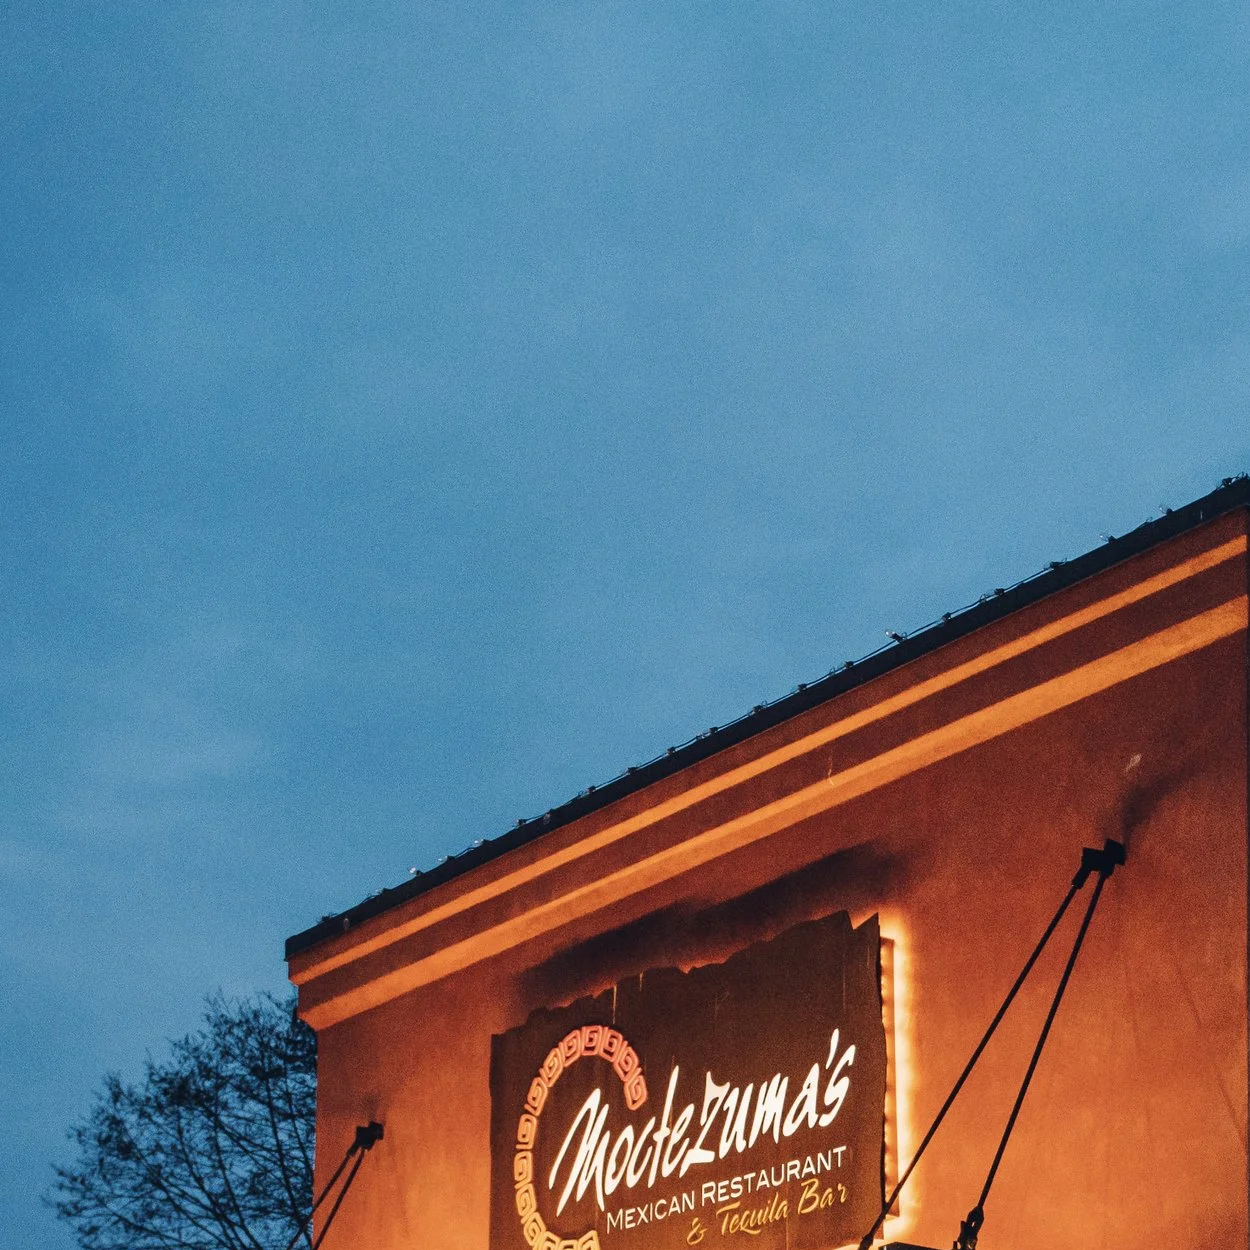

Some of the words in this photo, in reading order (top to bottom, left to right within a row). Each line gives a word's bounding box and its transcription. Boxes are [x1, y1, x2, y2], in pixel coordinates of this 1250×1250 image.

[607, 1191, 695, 1234] MEXICAN
[701, 1145, 847, 1207] RESTAURANT
[686, 1217, 707, 1245] &
[715, 1192, 788, 1236] Tequila
[797, 1178, 848, 1214] Bar
